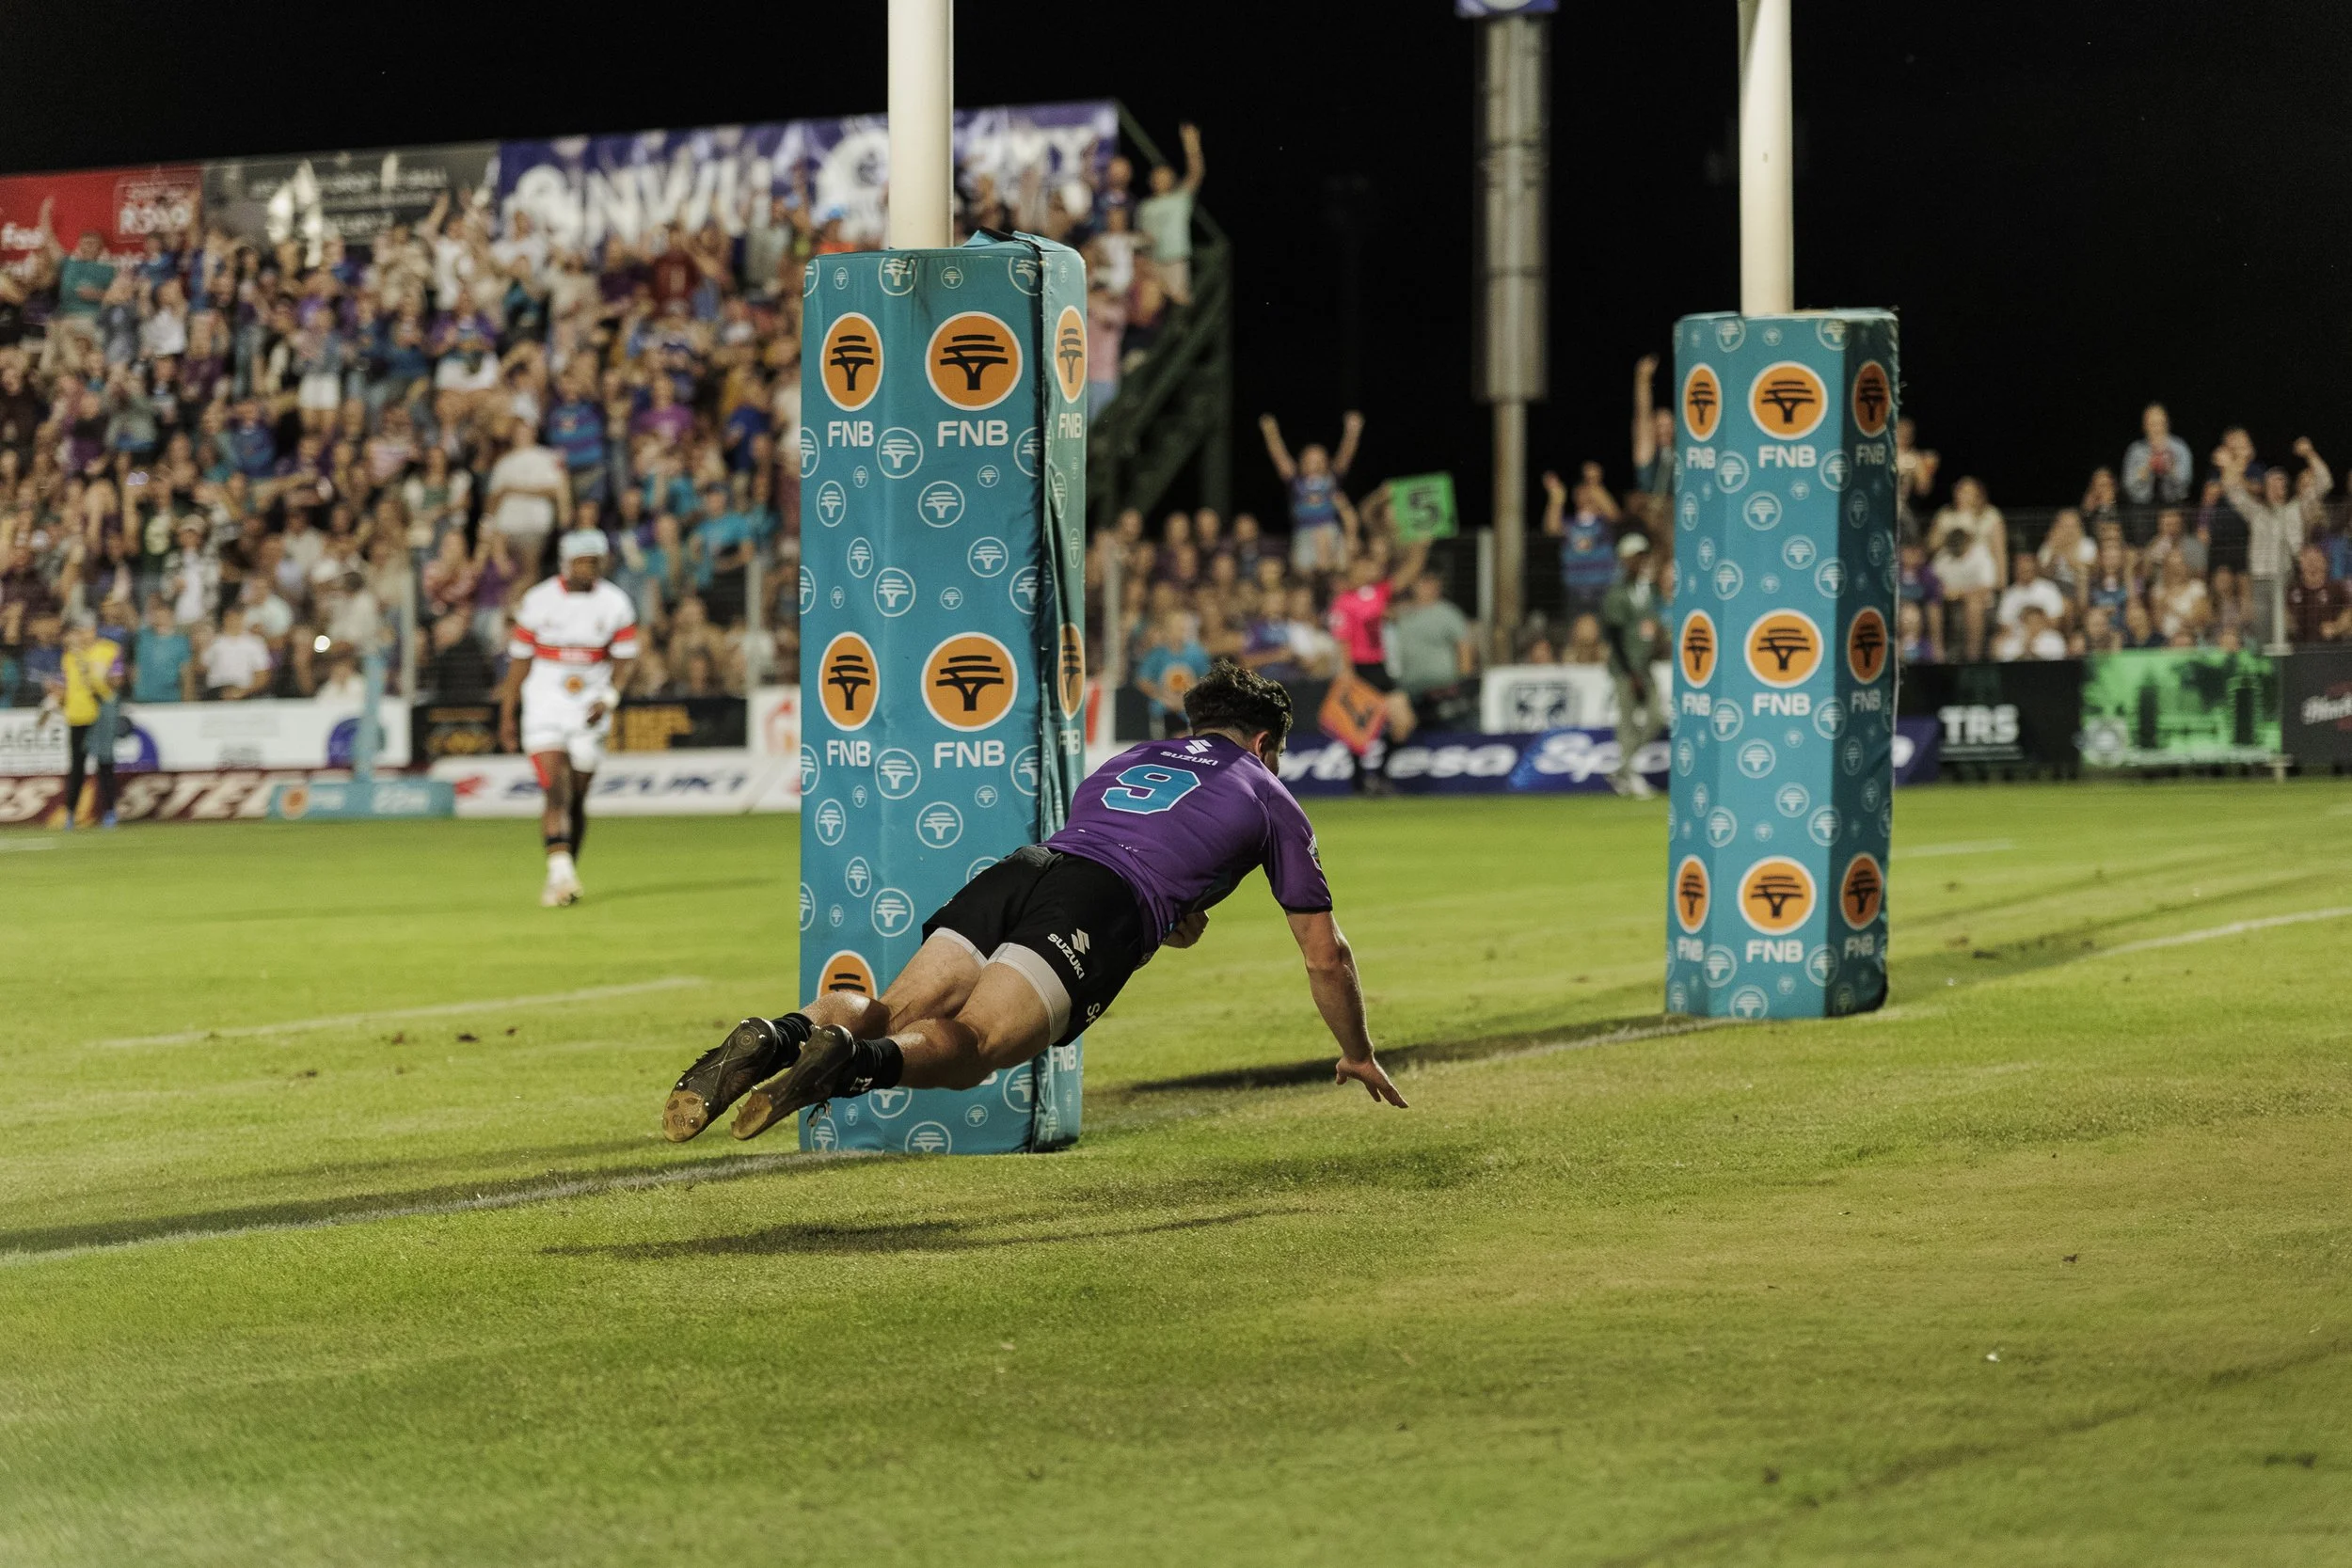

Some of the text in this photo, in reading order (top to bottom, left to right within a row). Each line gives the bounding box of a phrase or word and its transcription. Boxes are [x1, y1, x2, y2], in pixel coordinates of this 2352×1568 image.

[827, 420, 874, 448] FNB
[937, 420, 1009, 448] FNB
[1057, 412, 1083, 439] FNB
[1686, 446, 1716, 469] FNB
[1757, 444, 1817, 468] FNB
[1854, 443, 1886, 467] FNB
[1408, 487, 1440, 529] 5
[1681, 691, 1711, 716] FNB
[1752, 691, 1811, 716] FNB
[1851, 688, 1882, 713] FNB
[1937, 705, 2020, 745] TRS
[826, 739, 871, 767] FNB
[934, 739, 1006, 768] FNB
[1160, 751, 1219, 767] SUZUKI
[1101, 763, 1202, 816] 9
[1047, 933, 1085, 980] SUZUKI
[1744, 939, 1804, 963] FNB
[1843, 933, 1875, 960] FNB
[1050, 1044, 1077, 1071] FNB
